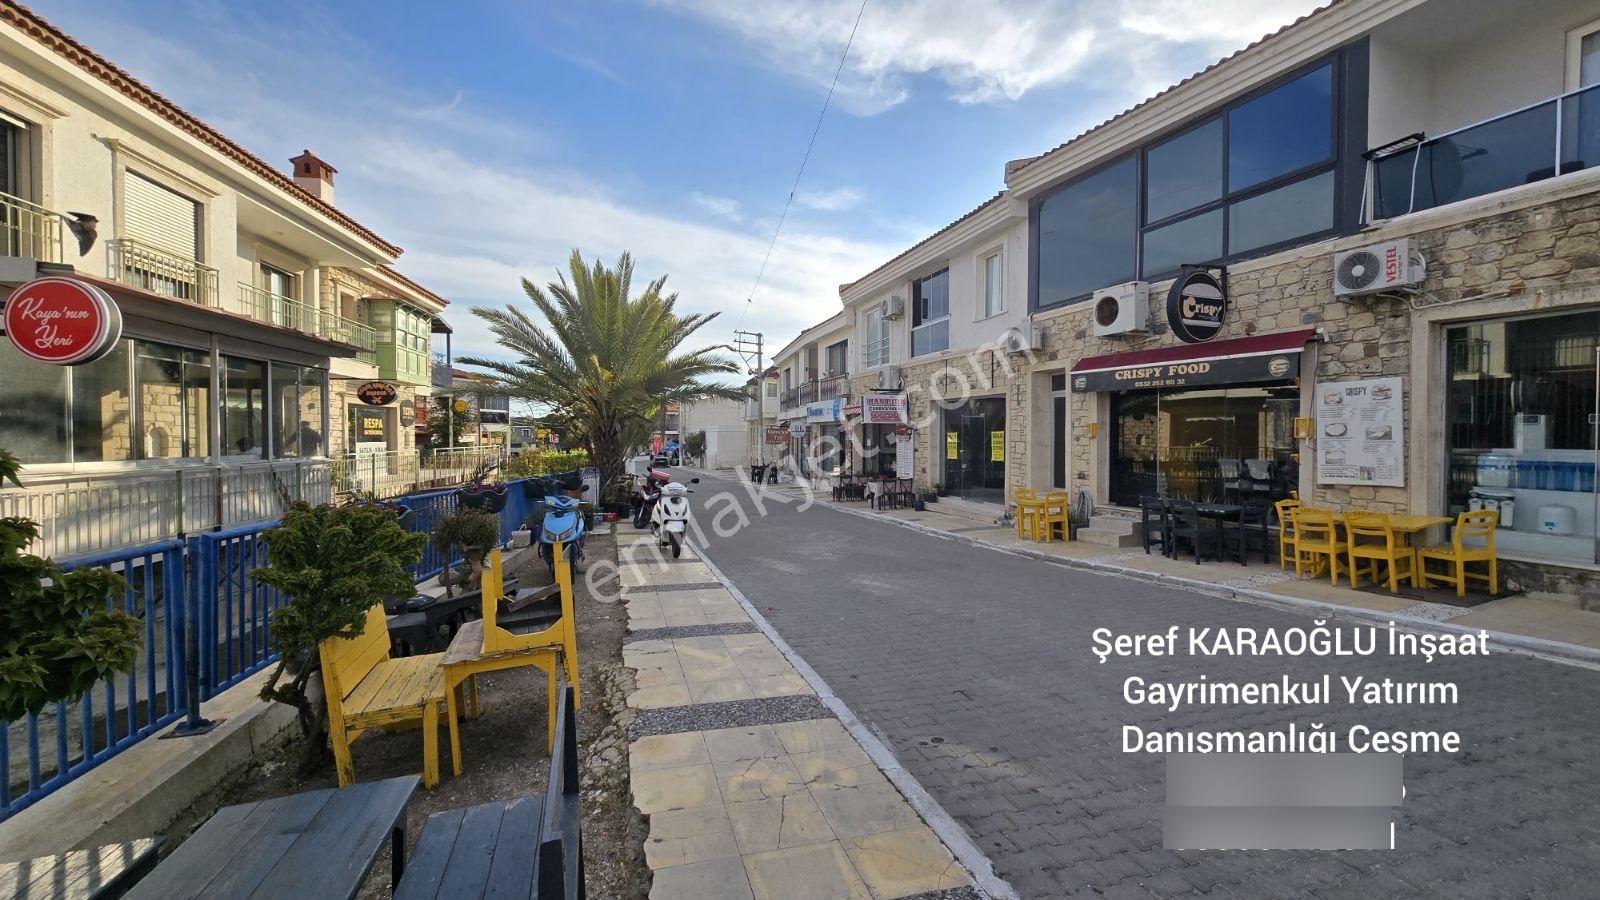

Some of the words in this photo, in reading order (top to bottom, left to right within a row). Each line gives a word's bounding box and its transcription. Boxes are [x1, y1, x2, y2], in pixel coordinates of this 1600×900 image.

[1386, 246, 1397, 283] VESTEL
[1183, 296, 1223, 318] Crispy
[34, 325, 73, 349] Yeri
[1115, 367, 1162, 380] CRISPY
[1168, 363, 1210, 376] FOOD
[1345, 386, 1368, 397] CRISPY
[363, 418, 383, 429] RESPA
